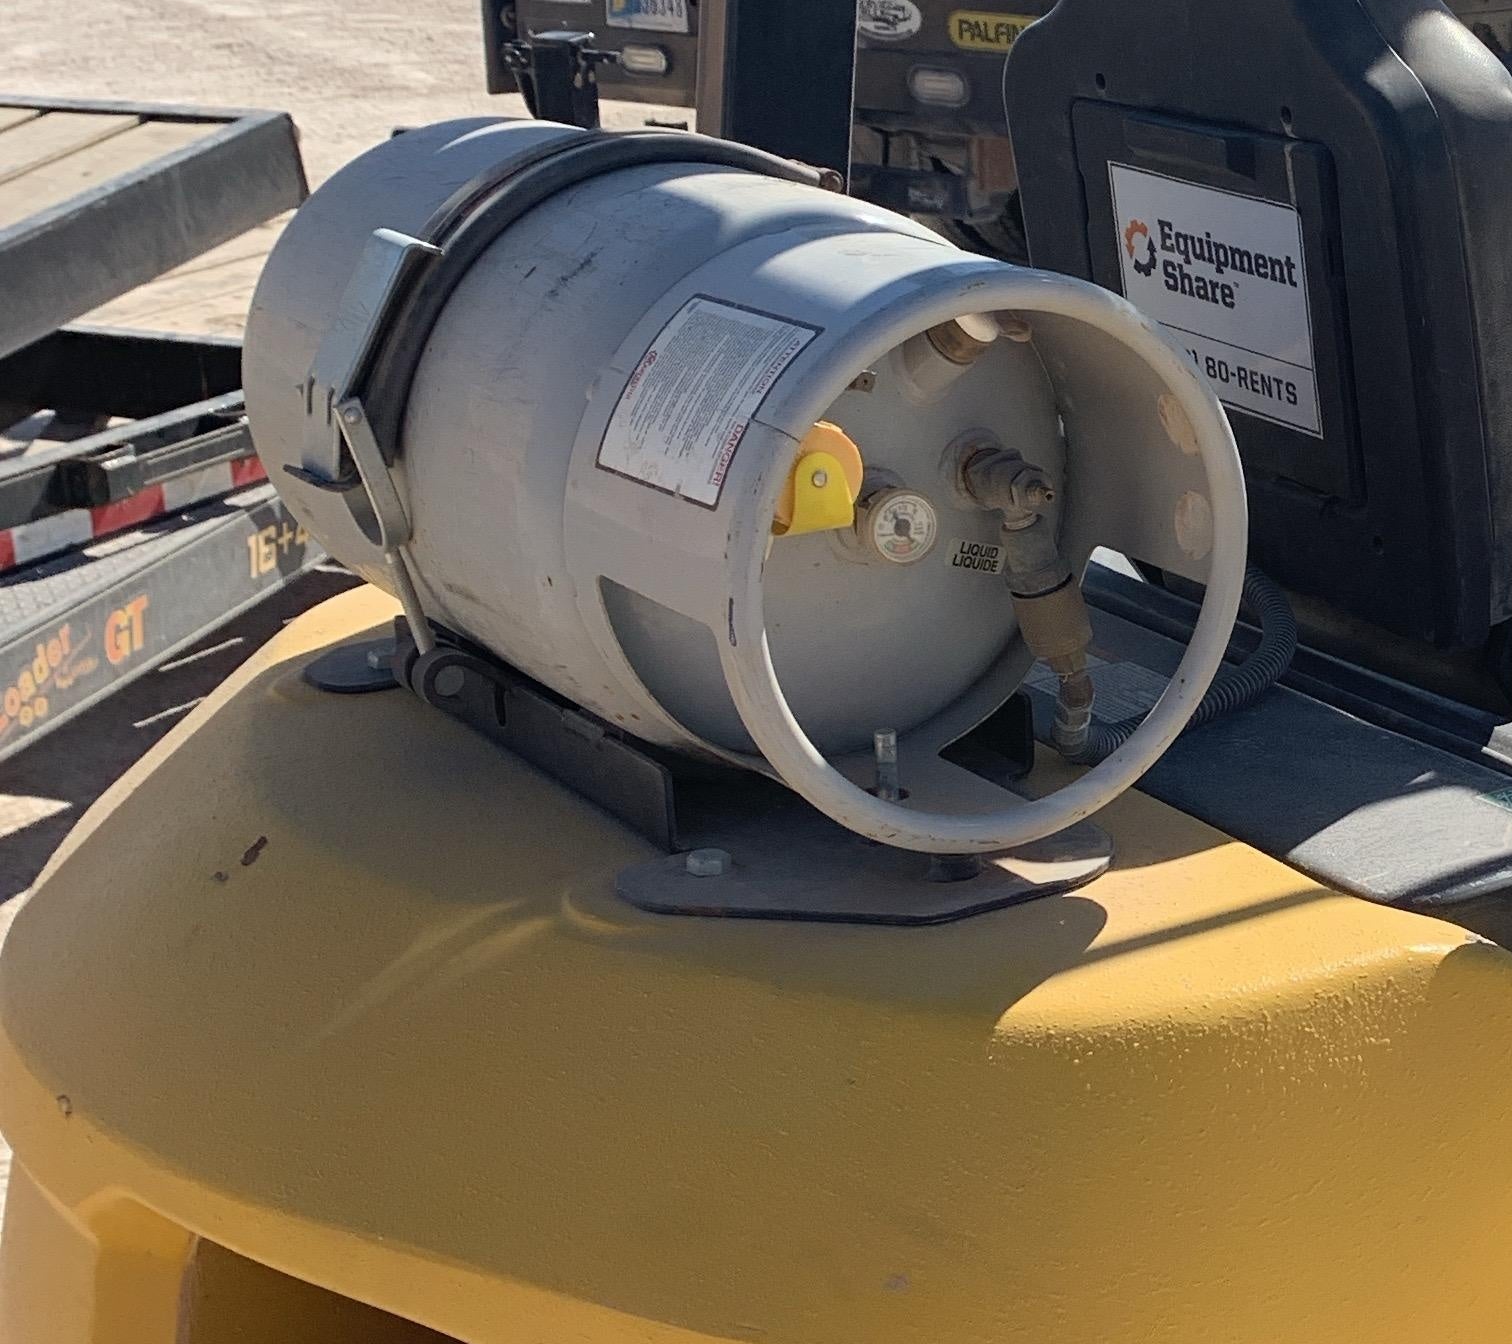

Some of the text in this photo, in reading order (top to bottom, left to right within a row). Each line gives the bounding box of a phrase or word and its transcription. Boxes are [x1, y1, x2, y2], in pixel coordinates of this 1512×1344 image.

[1157, 218, 1298, 288] Equipment
[1163, 258, 1236, 310] Share
[952, 554, 999, 572] LIQUIDE
[960, 541, 999, 557] LIQUID
[104, 594, 148, 665] GT
